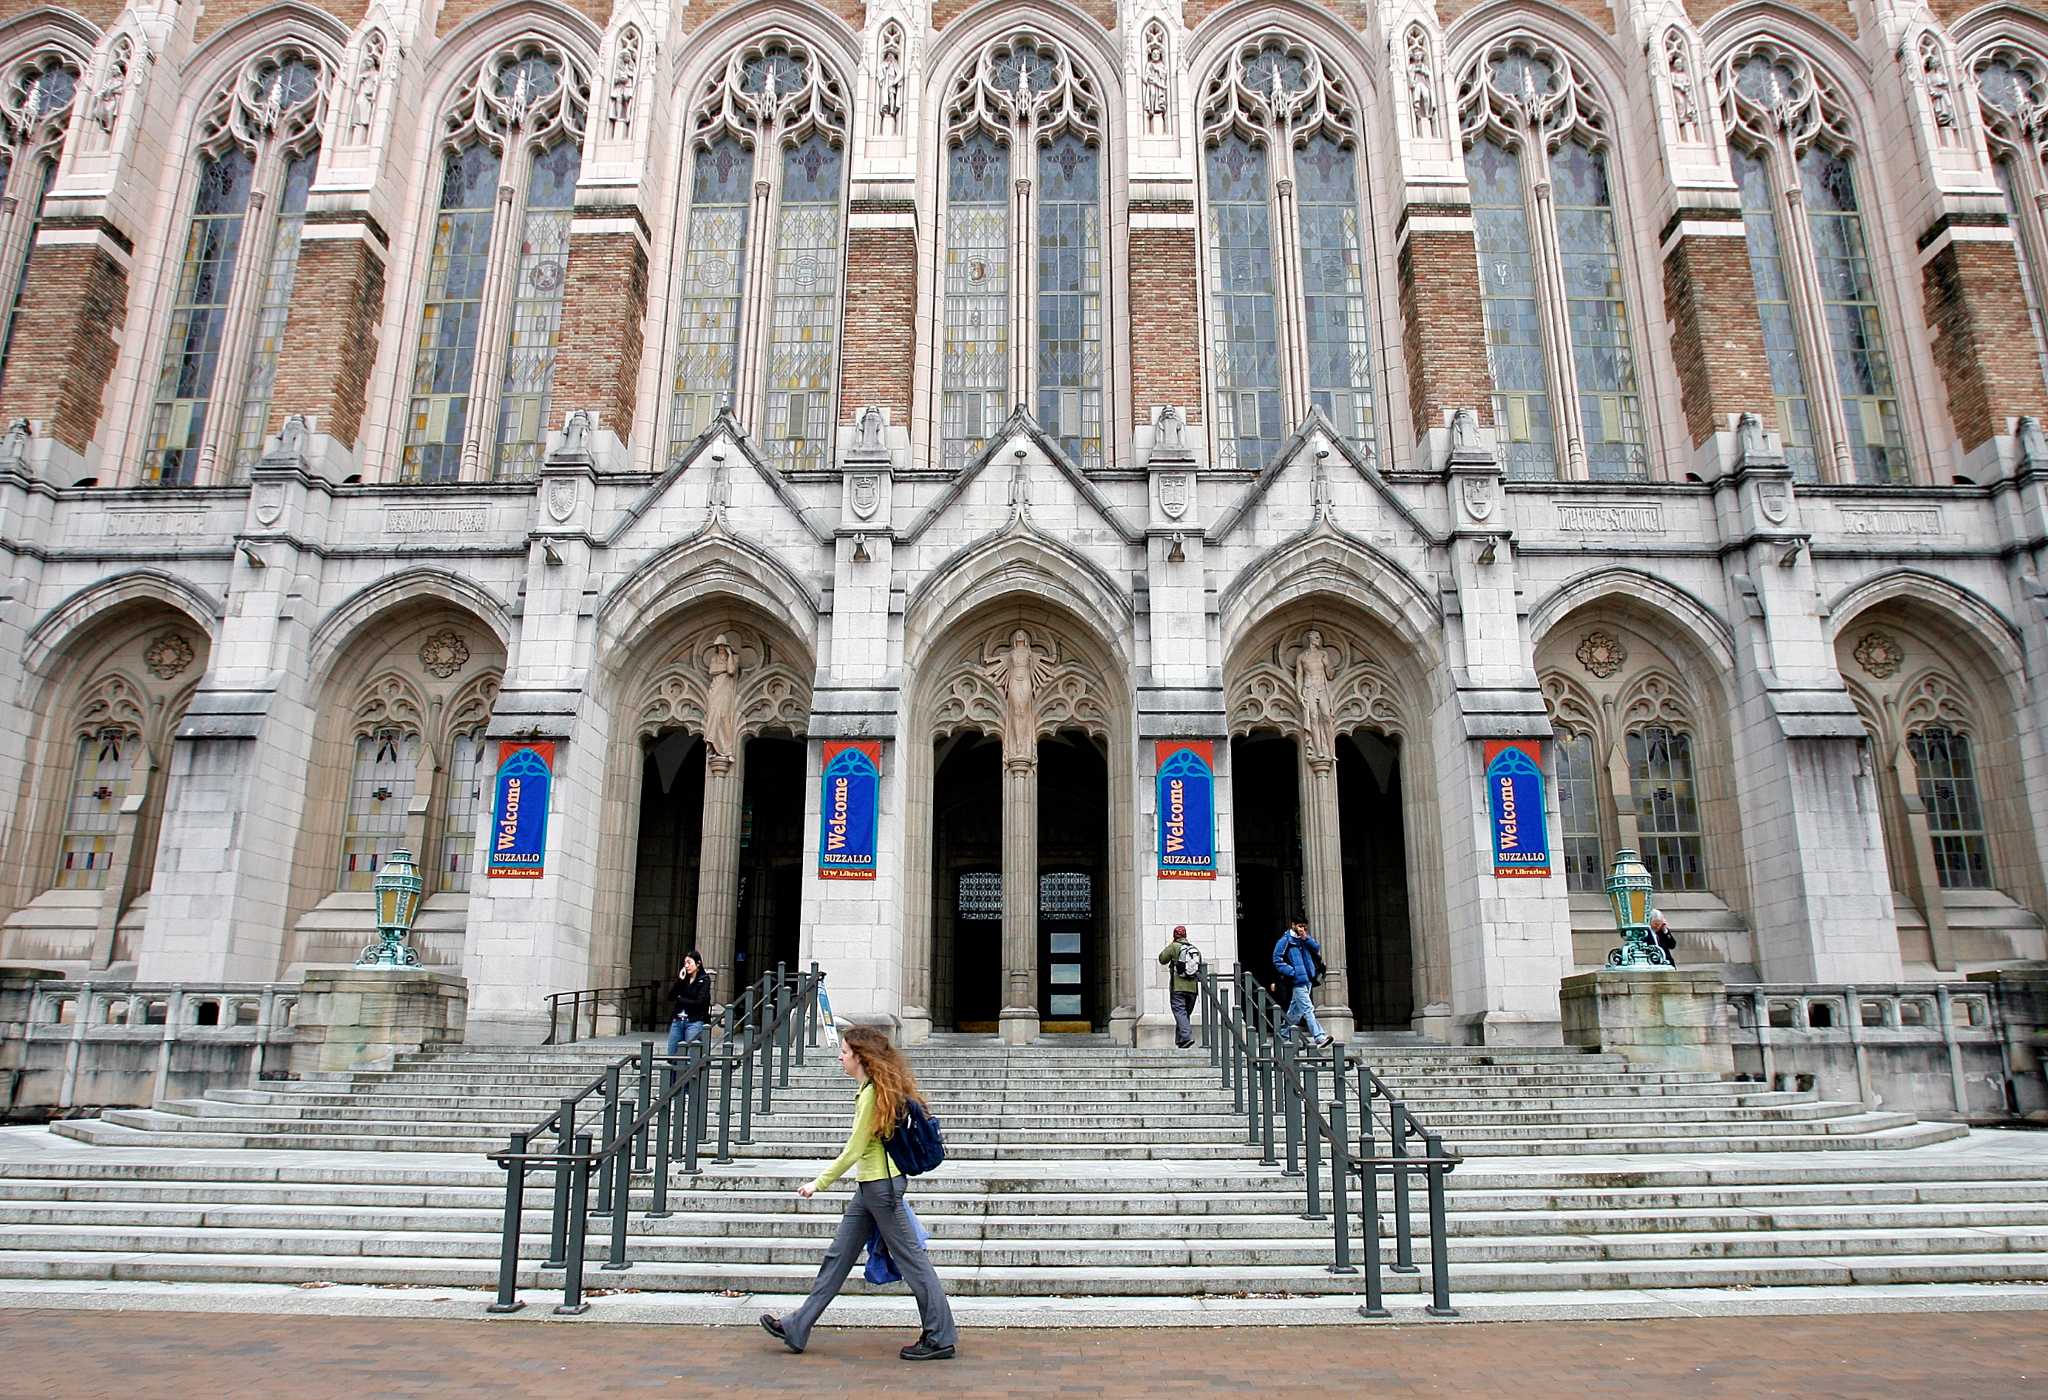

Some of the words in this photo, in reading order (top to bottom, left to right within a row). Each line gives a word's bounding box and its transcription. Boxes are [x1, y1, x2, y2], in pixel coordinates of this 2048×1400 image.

[498, 778, 521, 850] Welcome
[828, 777, 848, 851] Welcome
[1166, 779, 1184, 853] Welcome
[1499, 777, 1518, 850] Welcome
[493, 853, 540, 862] SUZZALLO
[824, 854, 871, 863] SUZZALLO
[1163, 856, 1211, 864] SUZZALLO
[1499, 853, 1544, 861] SUZZALLO
